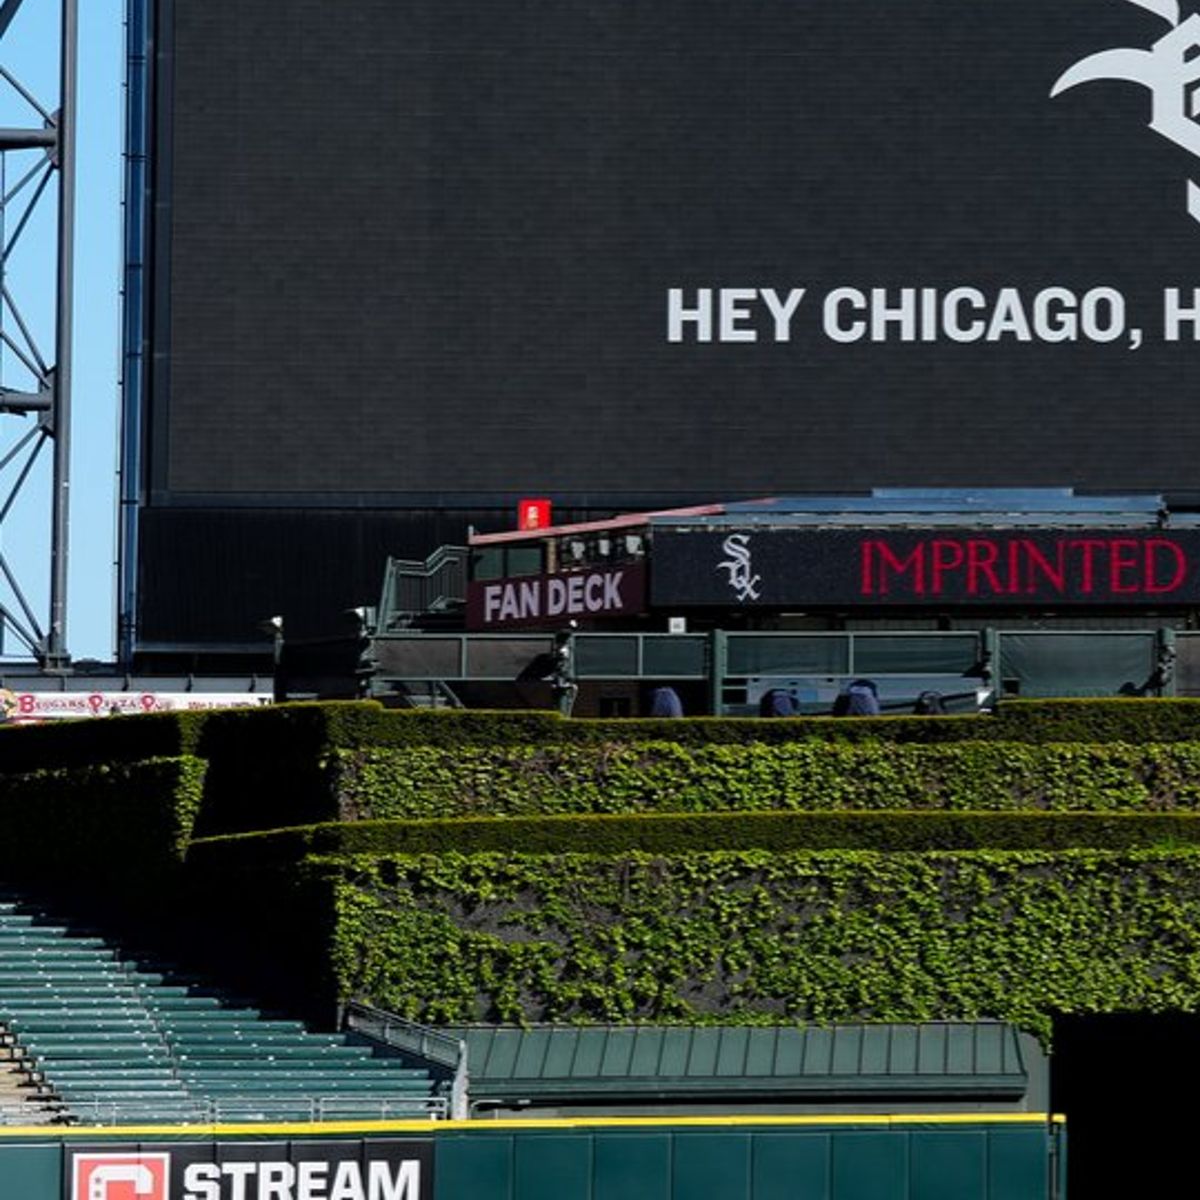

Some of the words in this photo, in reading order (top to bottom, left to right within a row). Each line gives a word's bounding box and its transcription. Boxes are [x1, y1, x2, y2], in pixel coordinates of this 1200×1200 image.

[667, 288, 805, 341] HEY
[823, 287, 1142, 350] CHICAGO,
[860, 539, 1186, 593] IMPRINTED
[484, 581, 540, 622] FAN
[548, 571, 623, 615] DECK
[183, 1160, 420, 1200] STREAM
